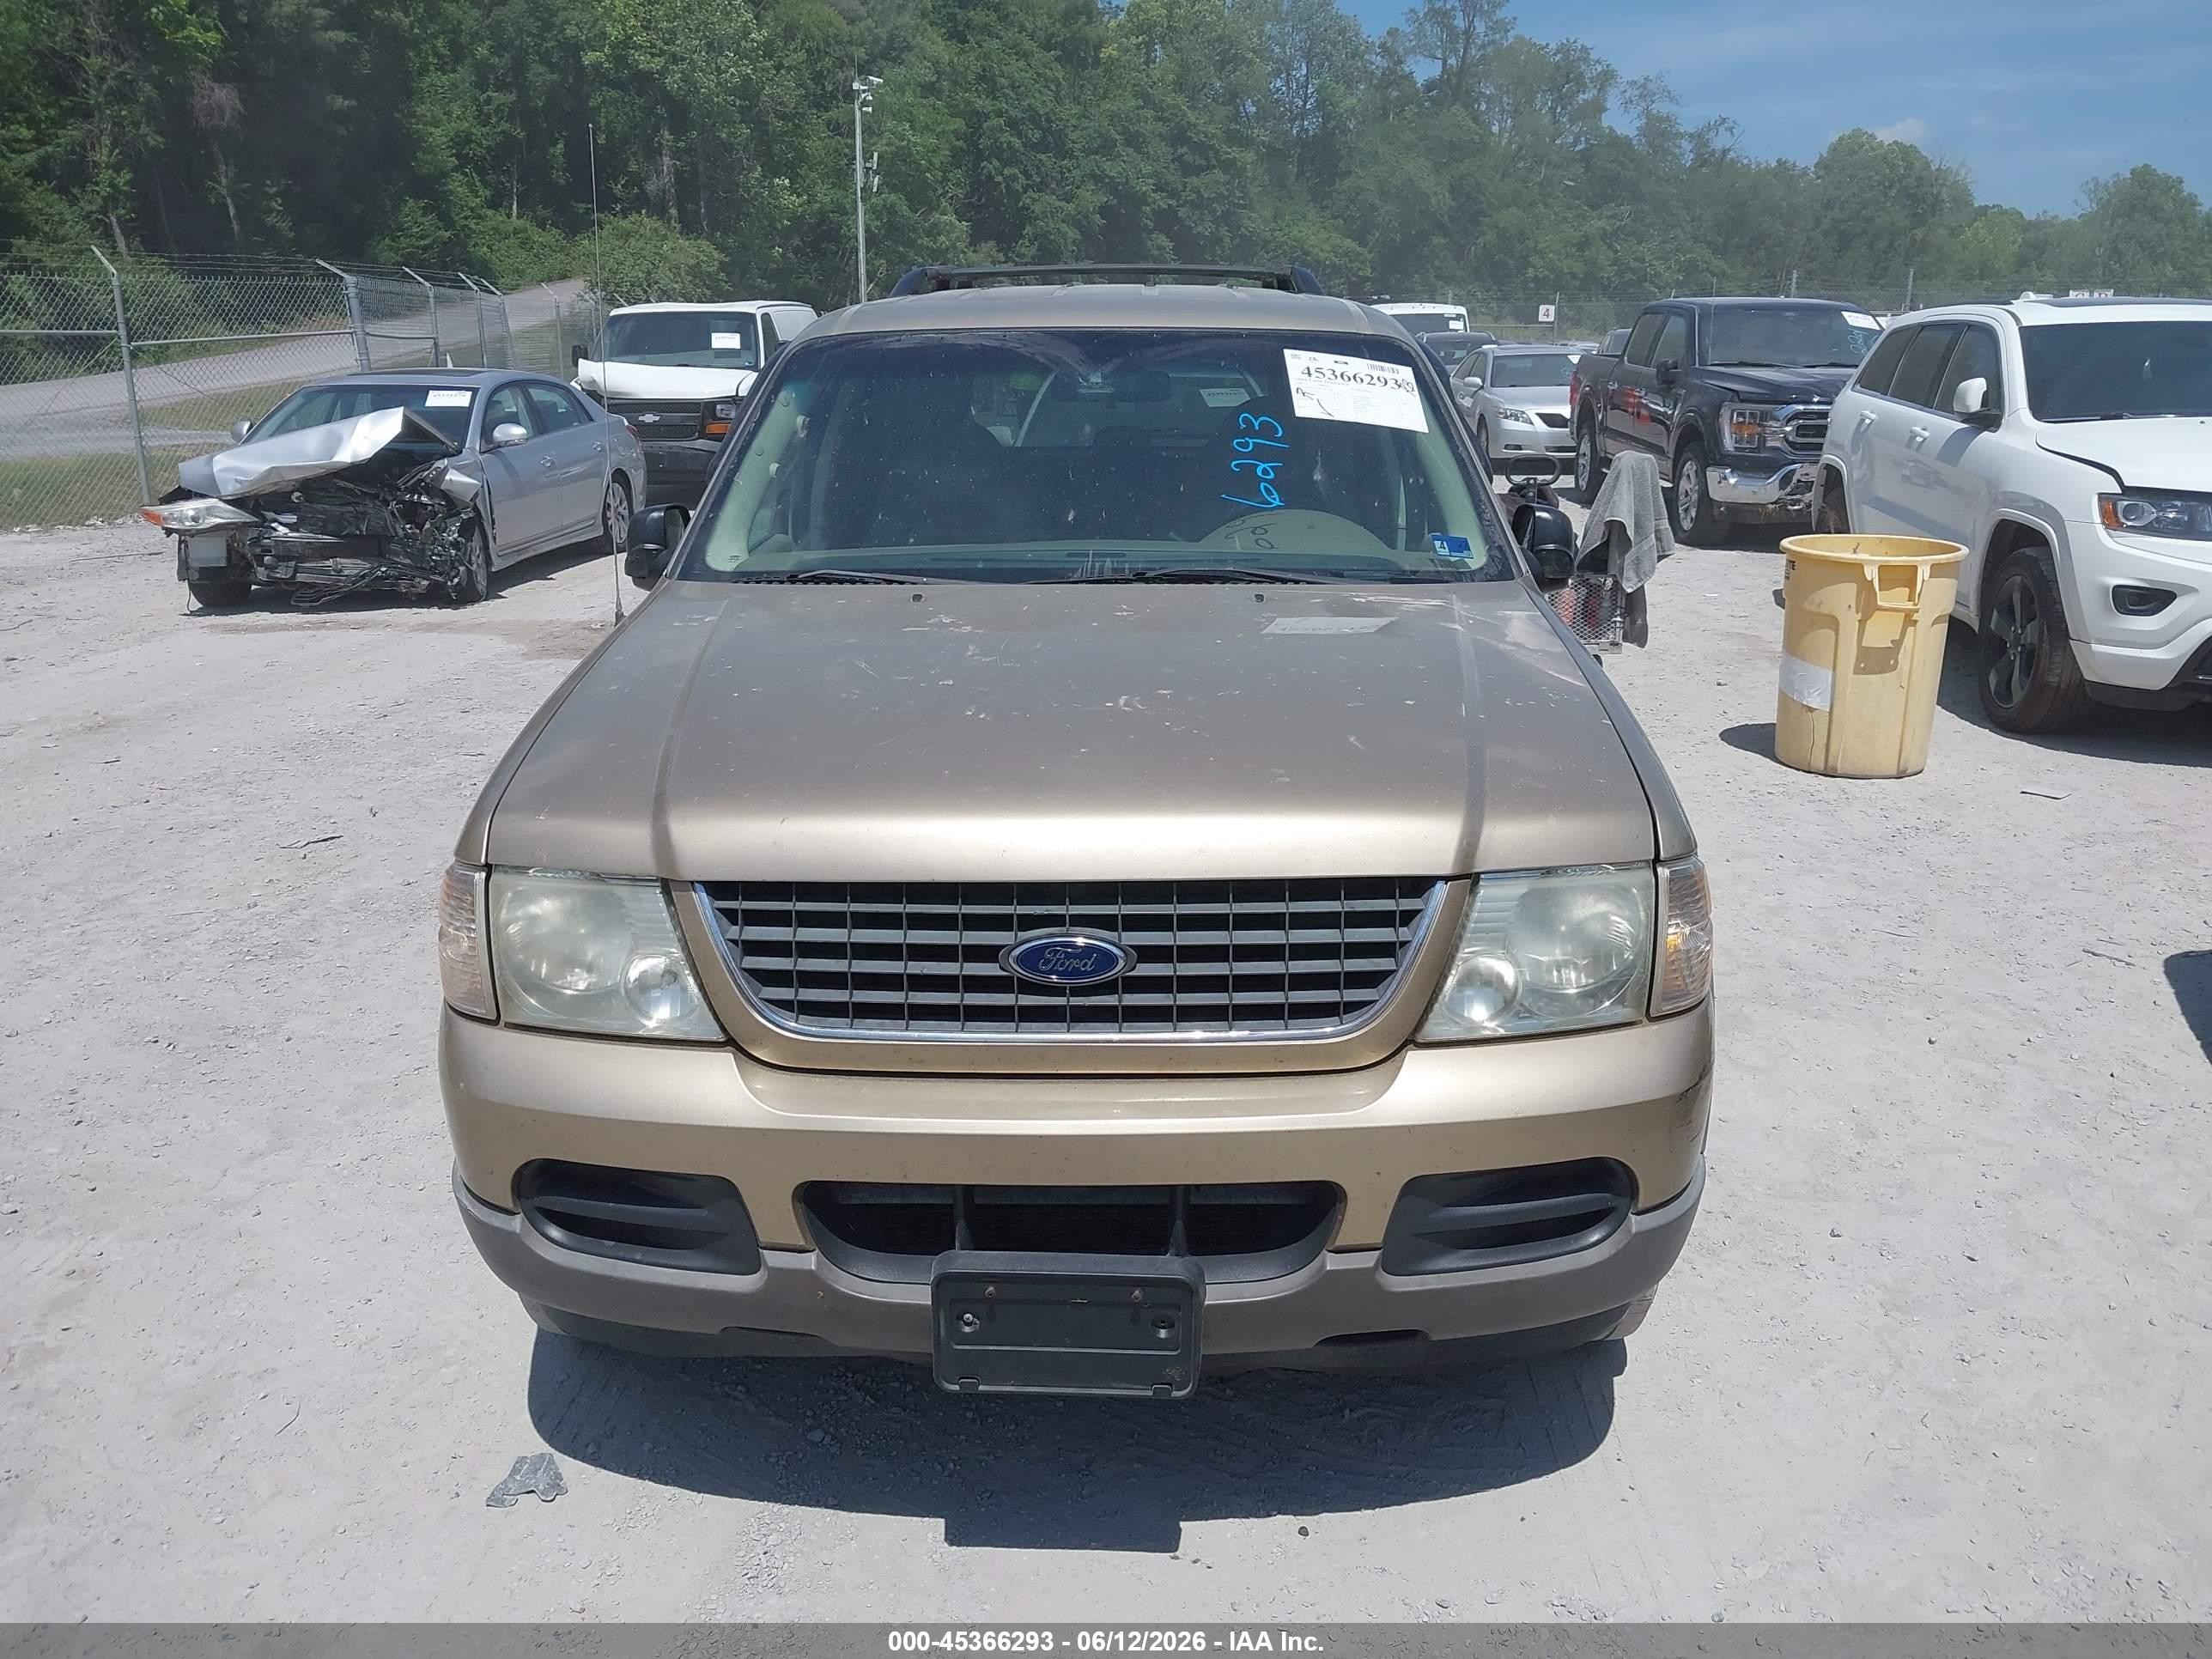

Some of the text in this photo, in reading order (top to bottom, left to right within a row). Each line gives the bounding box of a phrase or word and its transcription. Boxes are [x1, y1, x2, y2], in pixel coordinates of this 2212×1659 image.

[1542, 308, 1551, 319] 4
[1301, 366, 1401, 390] 45366293
[1220, 413, 1290, 507] 6293
[1038, 947, 1098, 971] Ford
